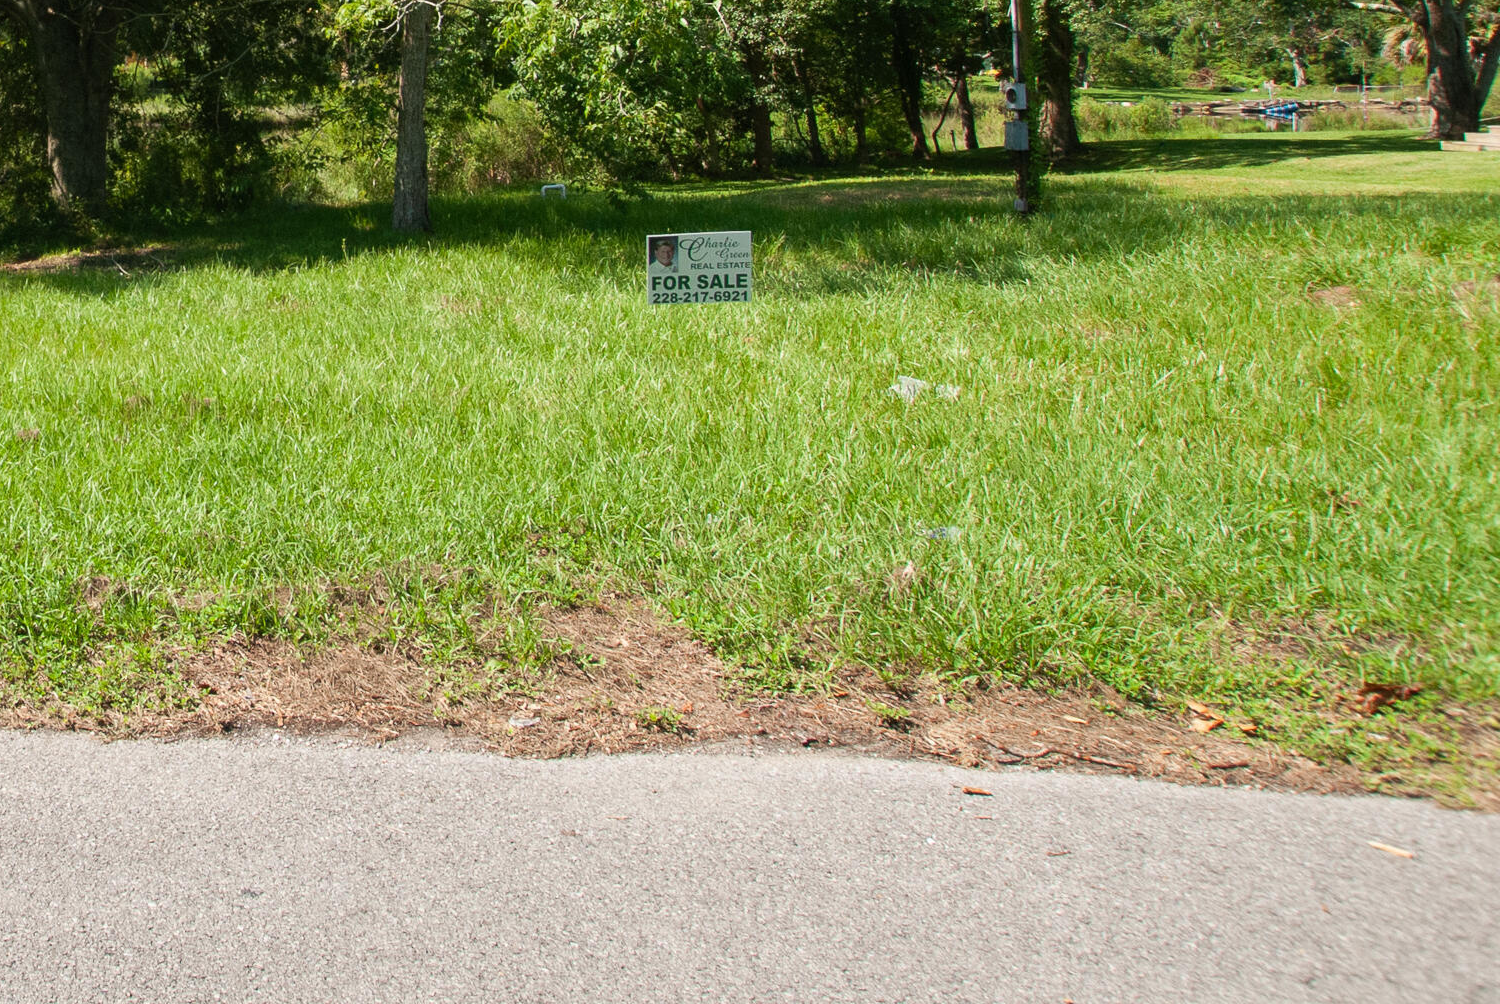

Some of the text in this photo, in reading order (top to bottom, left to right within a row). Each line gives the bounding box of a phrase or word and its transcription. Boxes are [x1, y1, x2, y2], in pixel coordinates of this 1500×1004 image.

[679, 236, 739, 261] Charlie
[716, 248, 749, 261] Green
[690, 261, 751, 270] REAL ESTATE
[652, 274, 748, 290] FOR SALE
[652, 291, 748, 304] 228-217-6921
